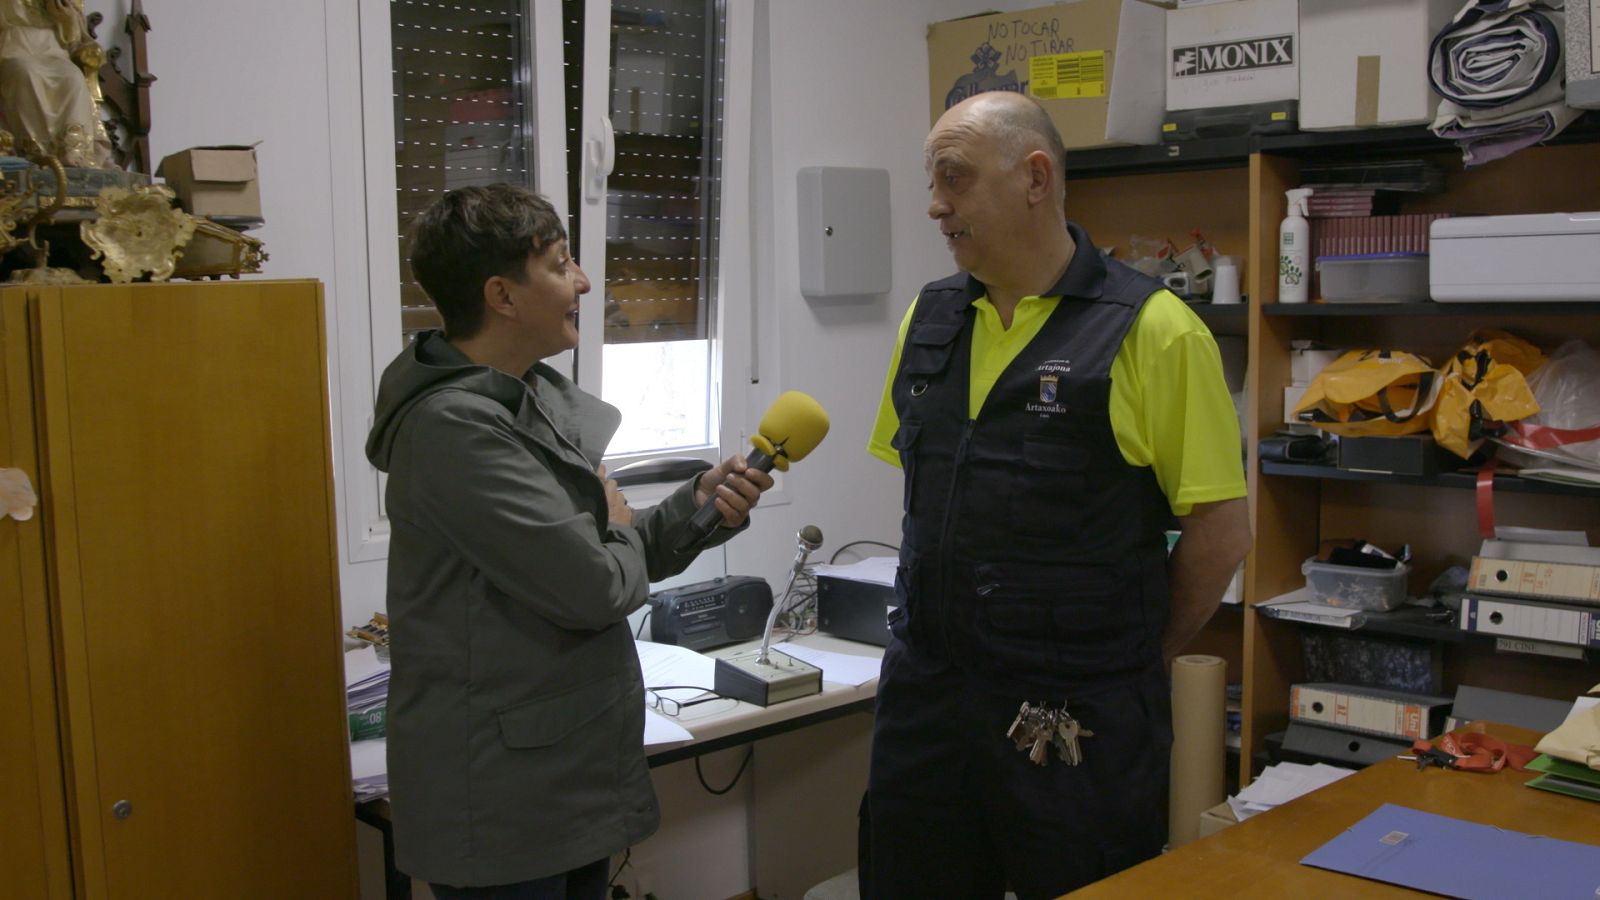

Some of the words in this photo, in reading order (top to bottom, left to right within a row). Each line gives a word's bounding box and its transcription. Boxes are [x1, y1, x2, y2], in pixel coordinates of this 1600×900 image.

[988, 23, 1008, 39] NO
[1012, 18, 1060, 40] TOCAR
[1006, 44, 1027, 64] NO
[1031, 38, 1075, 56] TIRAR
[1199, 38, 1293, 71] MONIX
